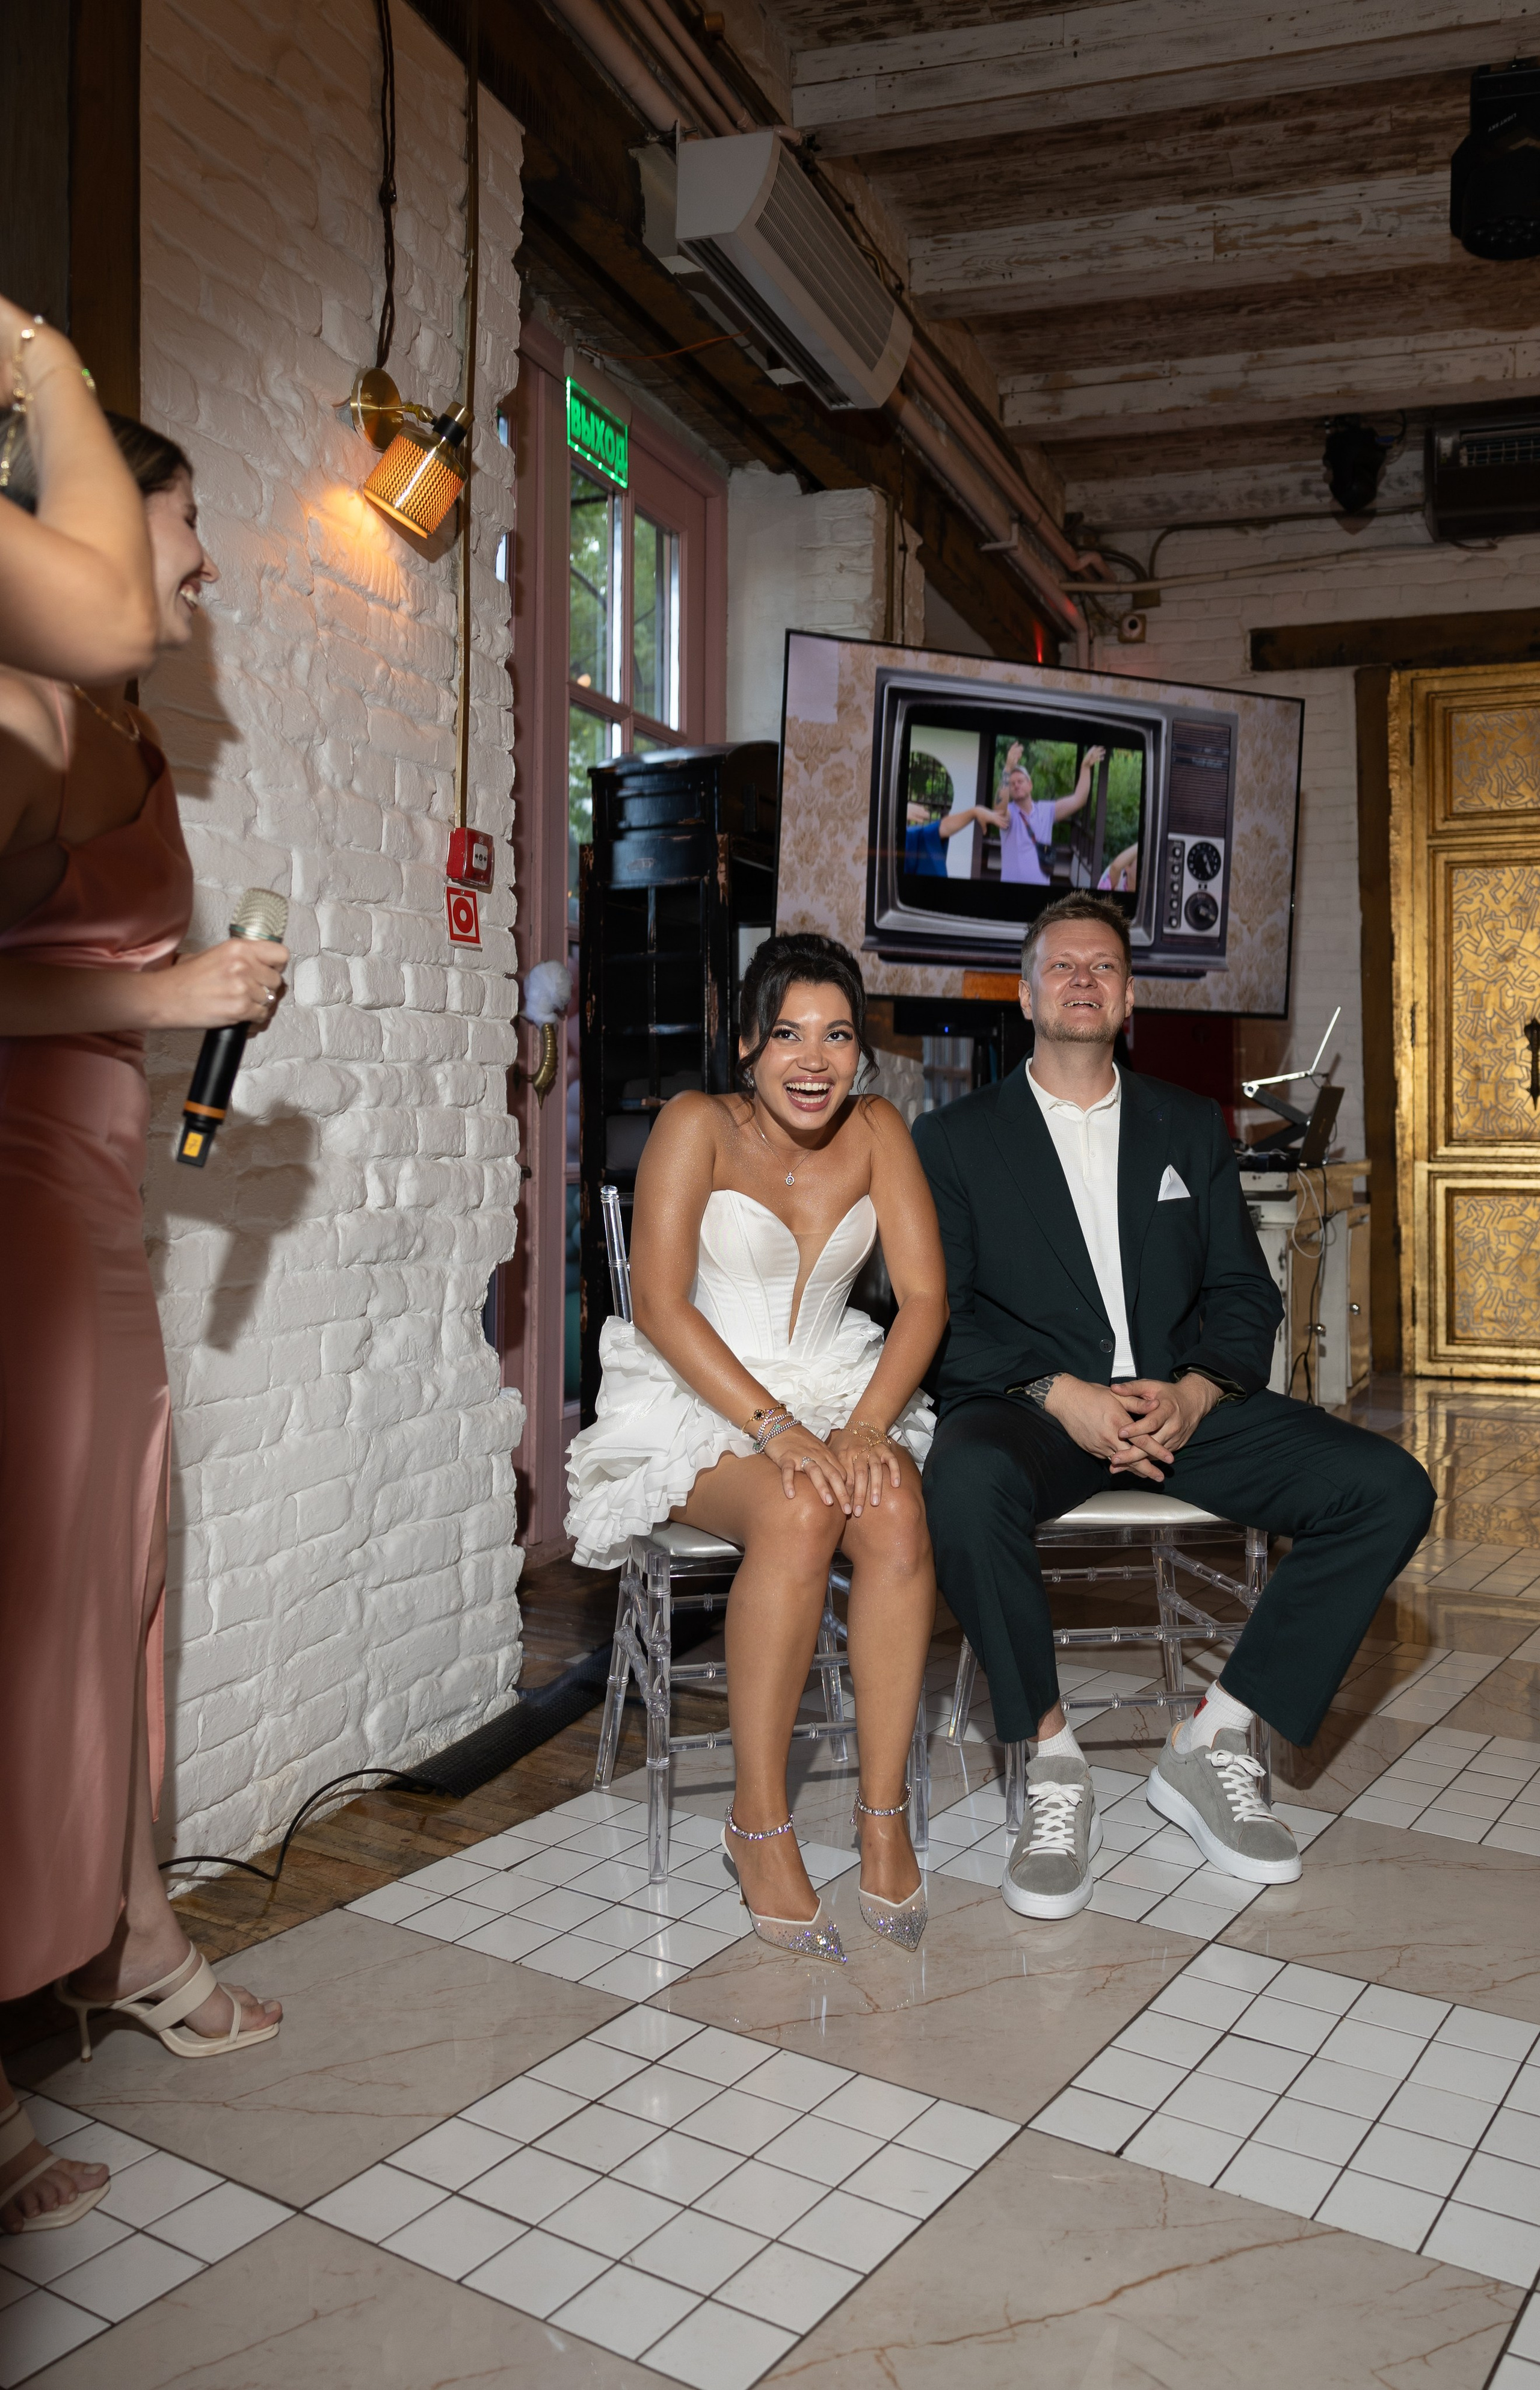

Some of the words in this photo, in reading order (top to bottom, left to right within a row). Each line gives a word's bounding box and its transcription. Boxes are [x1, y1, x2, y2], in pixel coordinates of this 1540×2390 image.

[1500, 113, 1517, 126] LIGHT
[1488, 123, 1499, 132] SKY
[571, 395, 627, 479] ВЫХОД
